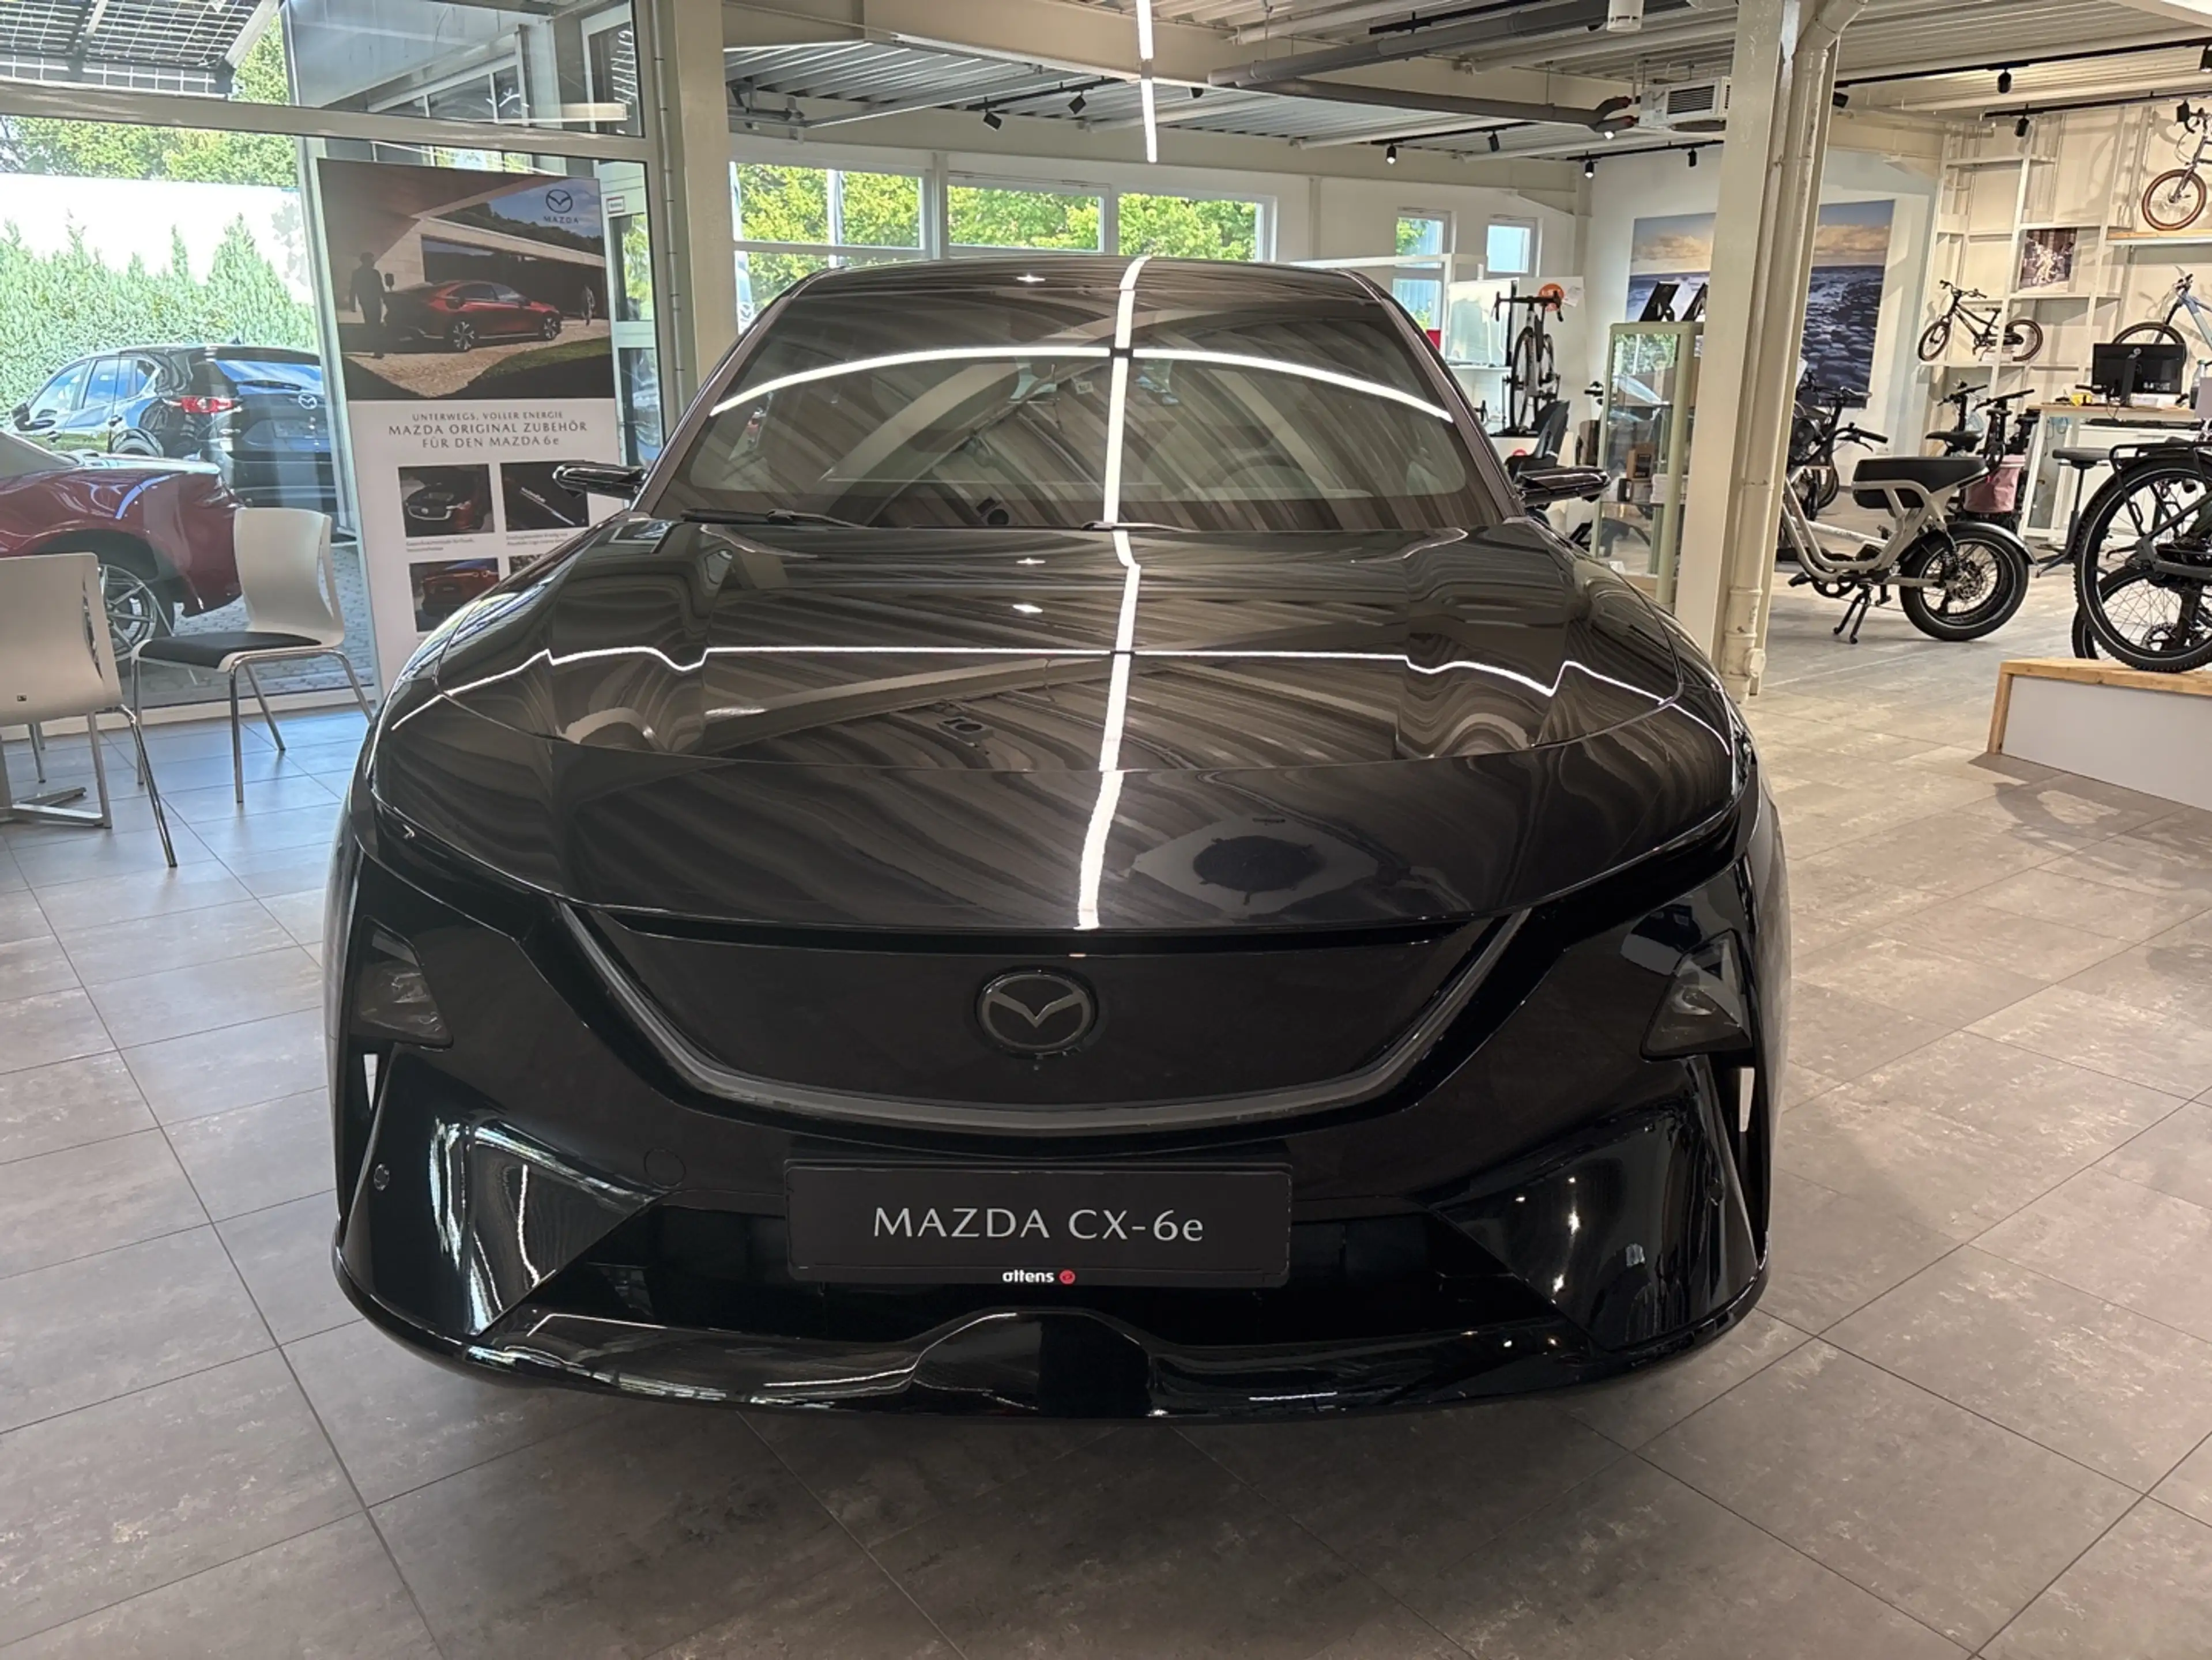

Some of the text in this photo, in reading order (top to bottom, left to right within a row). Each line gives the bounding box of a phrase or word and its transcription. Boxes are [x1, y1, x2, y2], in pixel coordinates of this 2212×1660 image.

[543, 216, 579, 224] MAZDA
[412, 410, 563, 422] UNTERWEGS, VOLLER ENERGIE
[388, 420, 587, 436] MAZDA ORIGINAL ZUBEHÖR
[423, 436, 450, 448] FÜR
[454, 437, 483, 448] DEN
[873, 1207, 1204, 1242] MAZDA CX-6e
